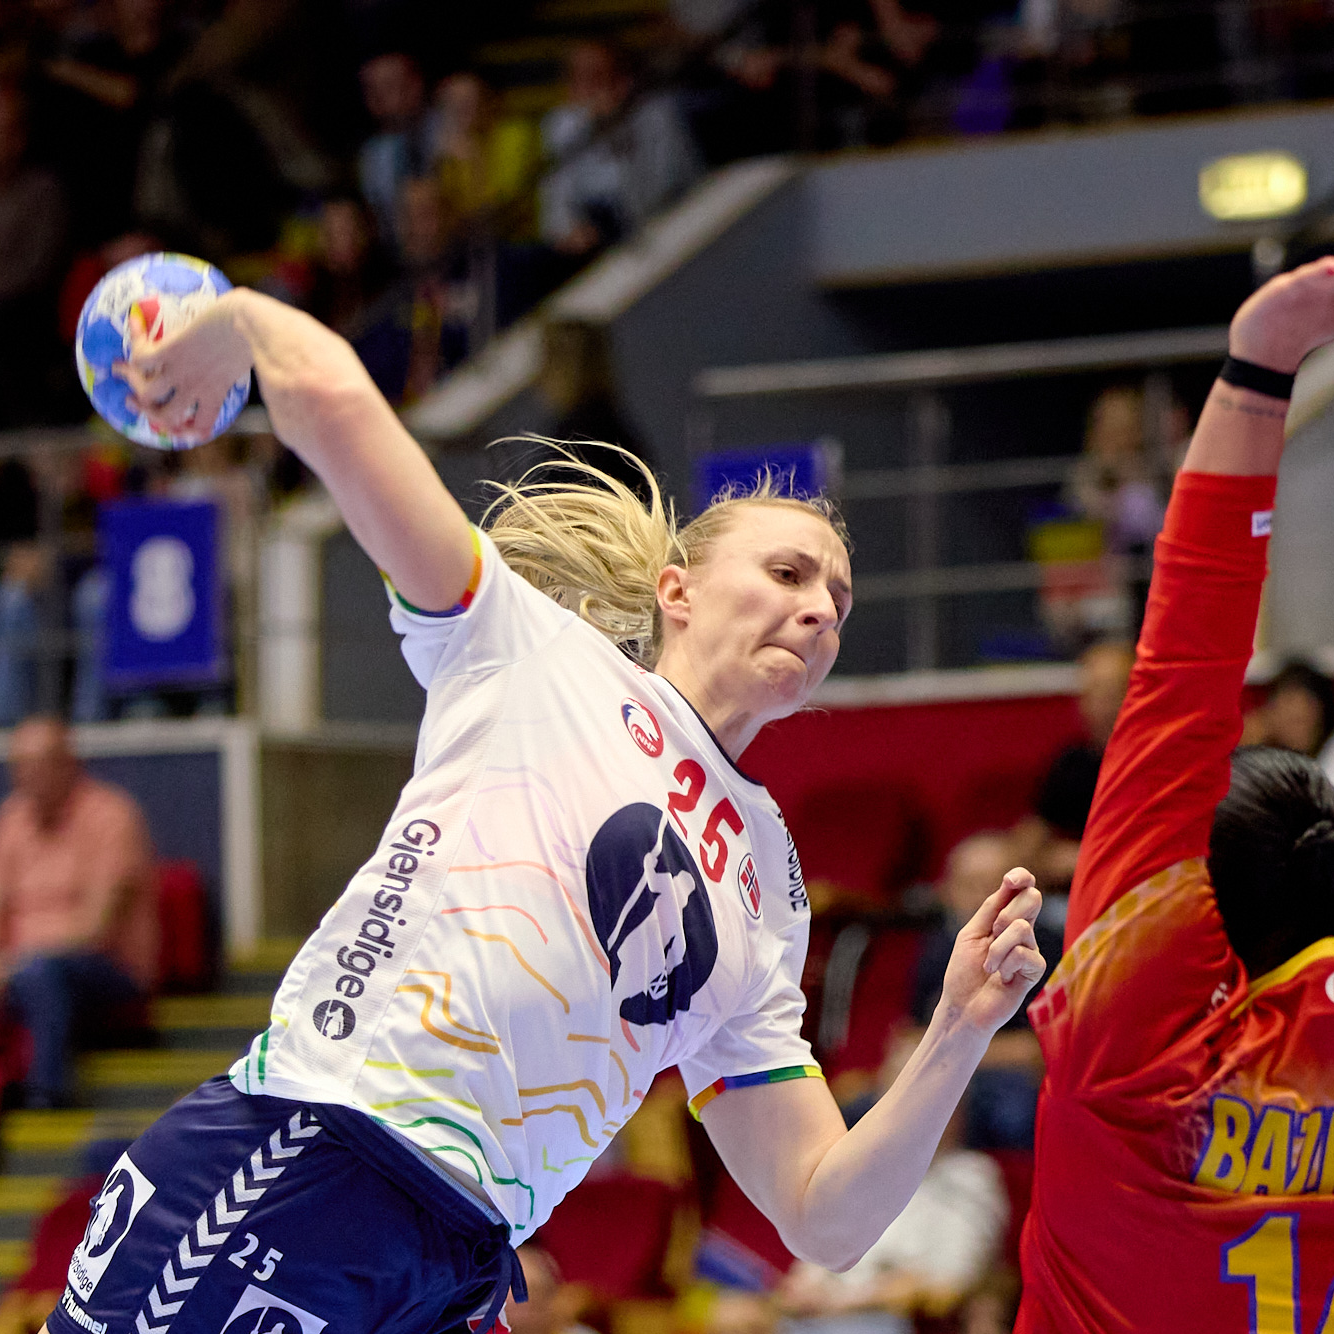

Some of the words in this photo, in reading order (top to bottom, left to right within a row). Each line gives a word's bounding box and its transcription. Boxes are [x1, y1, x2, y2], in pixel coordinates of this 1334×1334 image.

[636, 731, 658, 753] NHF
[667, 758, 745, 883] 25
[335, 818, 442, 999] Gjensidige
[227, 1231, 285, 1282] 25
